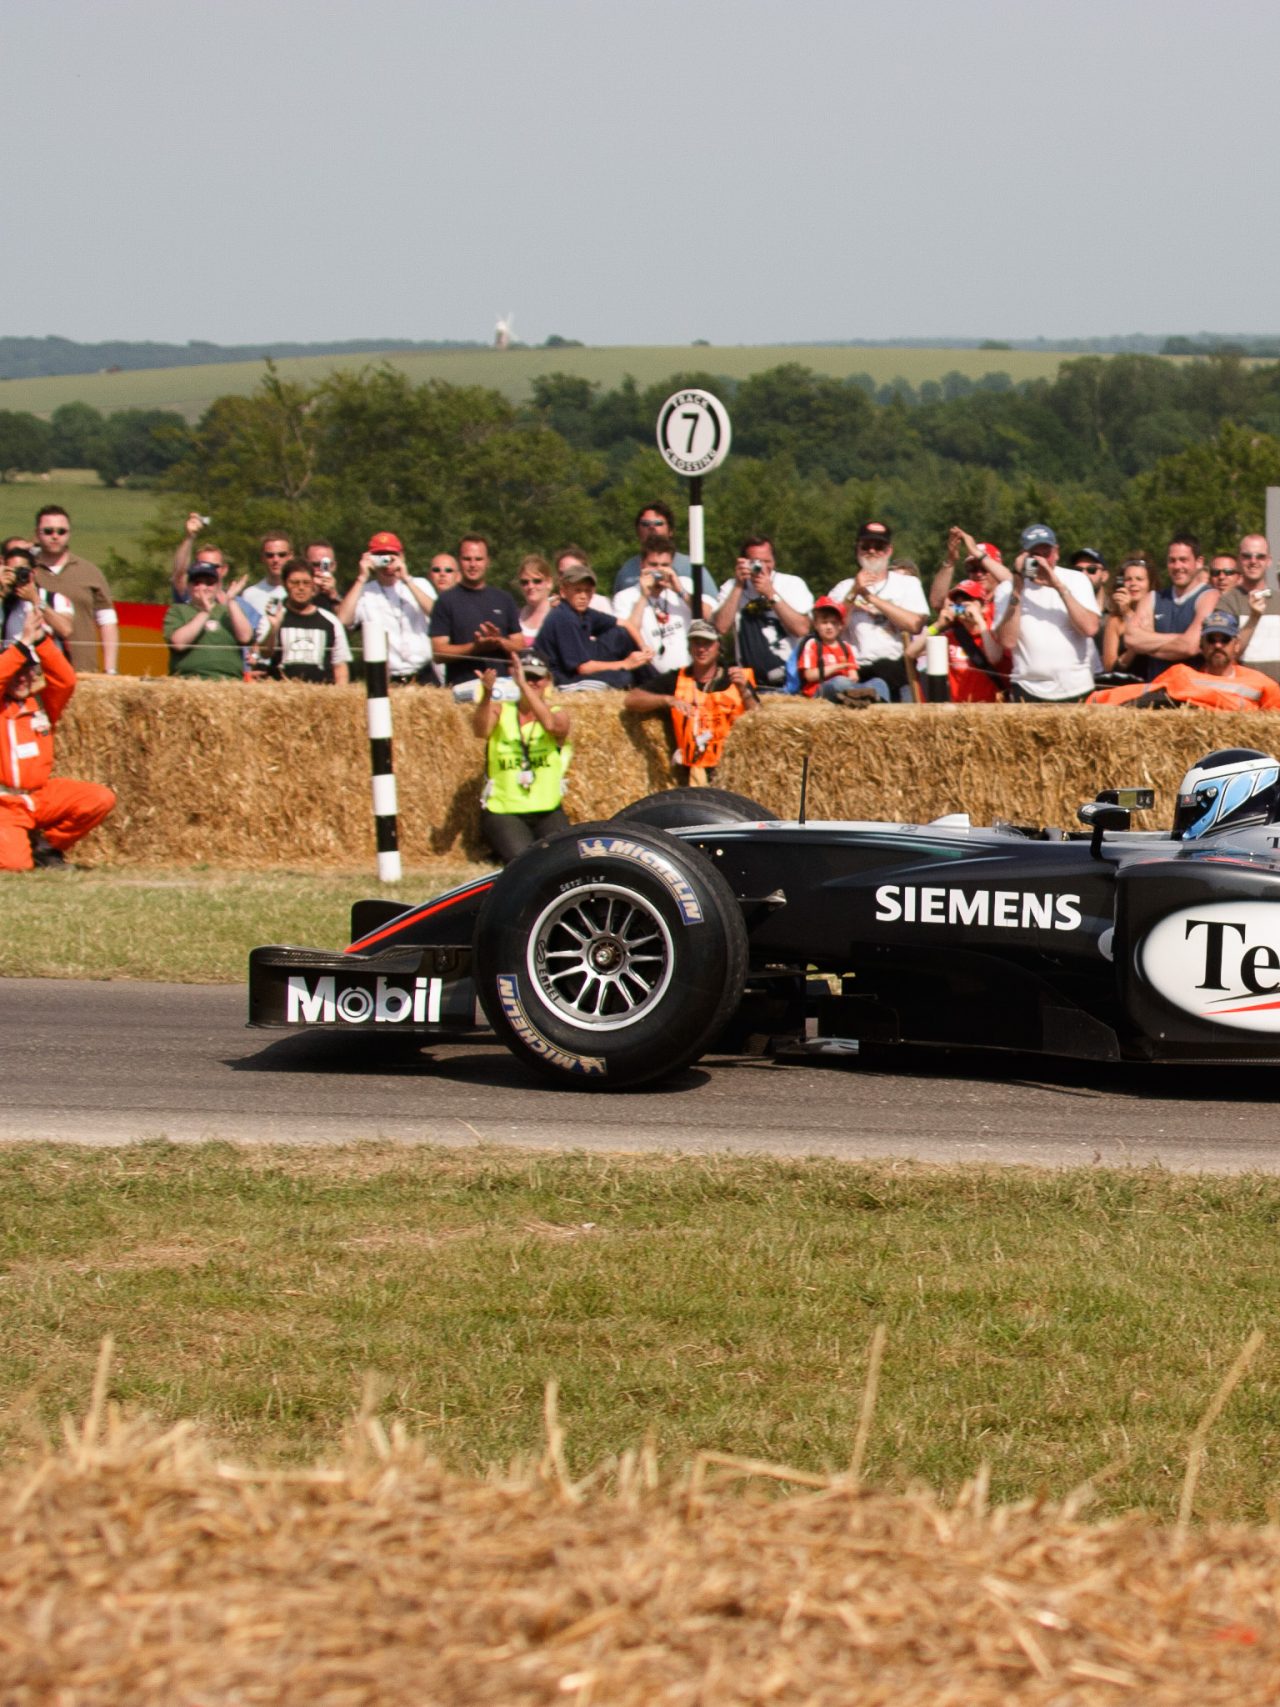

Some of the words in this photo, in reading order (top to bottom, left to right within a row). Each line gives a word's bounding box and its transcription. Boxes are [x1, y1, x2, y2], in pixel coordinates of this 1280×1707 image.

[682, 412, 699, 453] 7
[498, 755, 550, 770] MARHAL
[608, 840, 701, 919] MICHELIN
[875, 885, 1082, 931] SIEMENS
[287, 976, 442, 1023] Mobil
[499, 978, 577, 1070] MICHELIN
